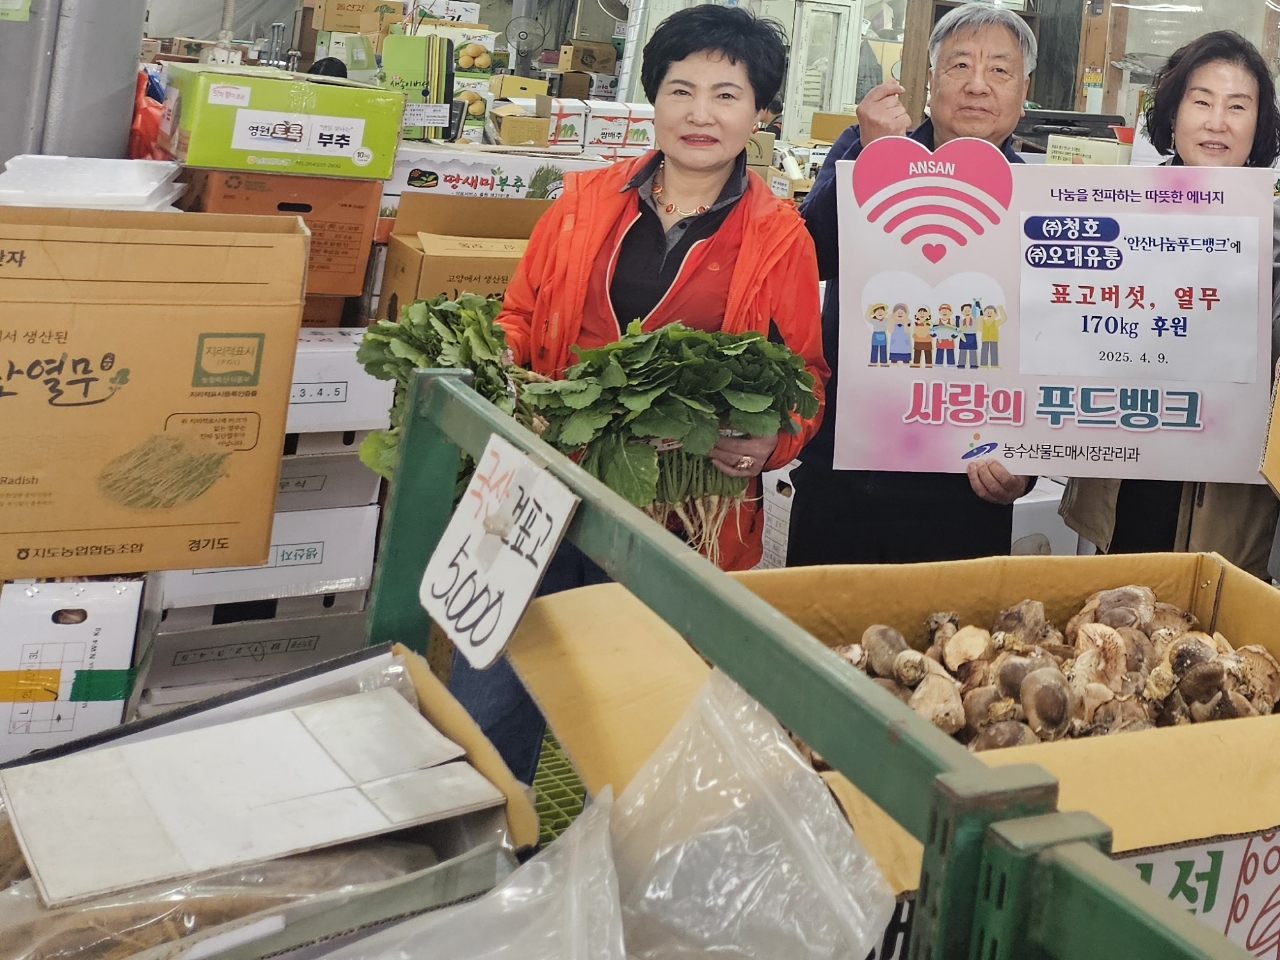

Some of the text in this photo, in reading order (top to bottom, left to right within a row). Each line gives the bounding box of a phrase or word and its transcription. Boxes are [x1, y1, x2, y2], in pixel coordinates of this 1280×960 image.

[317, 132, 351, 149] 부추
[907, 159, 956, 177] ANSAN
[1050, 187, 1225, 206] 나눔을 전파하는 따뜻한 에너지
[0, 250, 27, 268] 자
[446, 274, 509, 284] 고양에서 생산된
[1049, 283, 1222, 311] 표고버섯, 열무
[1080, 313, 1189, 339] 170kg 후원
[0, 330, 70, 346] 서 생산된
[205, 345, 256, 357] 지리적표시
[1098, 350, 1170, 365] 2025. 4. 9.
[903, 380, 1204, 431] 사랑의 푸드뱅크
[1002, 442, 1142, 464] 농수산물도매시장관리과
[0, 476, 39, 487] Radish
[187, 537, 230, 553] 경기도
[280, 546, 319, 563] 생산자
